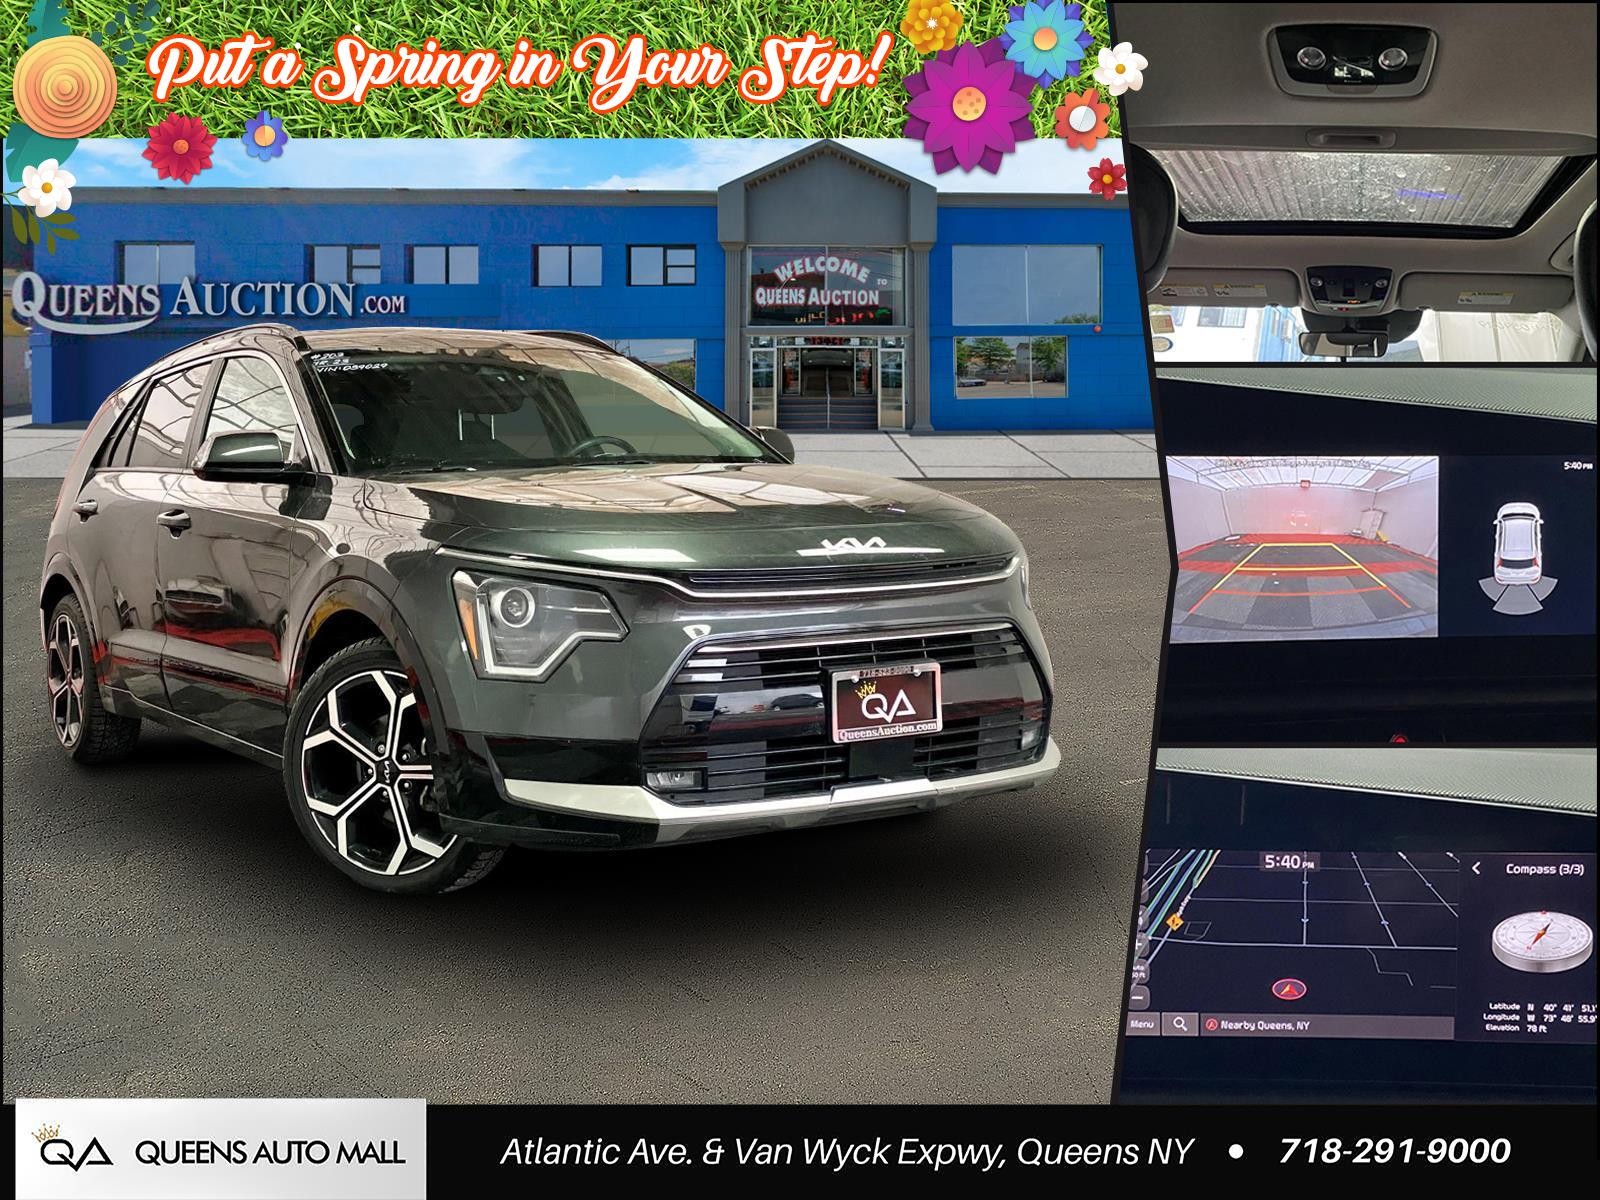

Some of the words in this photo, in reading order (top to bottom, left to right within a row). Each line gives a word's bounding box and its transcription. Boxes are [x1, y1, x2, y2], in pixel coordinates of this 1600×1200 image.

[774, 256, 871, 283] WELCOME
[876, 278, 888, 286] TO
[755, 287, 806, 307] QUEENS
[808, 287, 880, 306] AUCTION
[12, 271, 161, 335] QUEENS
[1563, 461, 1582, 470] 5:40
[839, 722, 937, 741] QueensAuction.com
[1264, 854, 1301, 869] 5:40
[1302, 861, 1315, 869] PM
[1506, 863, 1557, 875] Compass
[1559, 863, 1585, 876] (3/3)
[1489, 1002, 1520, 1010] Latitude
[1527, 1003, 1535, 1011] N
[1483, 1013, 1520, 1021] Longitude
[1526, 1013, 1535, 1022] W
[1130, 1020, 1154, 1028] Menu
[1220, 1020, 1256, 1031] Nearby
[1257, 1020, 1295, 1031] Queens,
[1296, 1021, 1310, 1030] NY
[1485, 1023, 1520, 1032] Elevation
[1526, 1024, 1538, 1032] 78
[1538, 1024, 1548, 1033] ft
